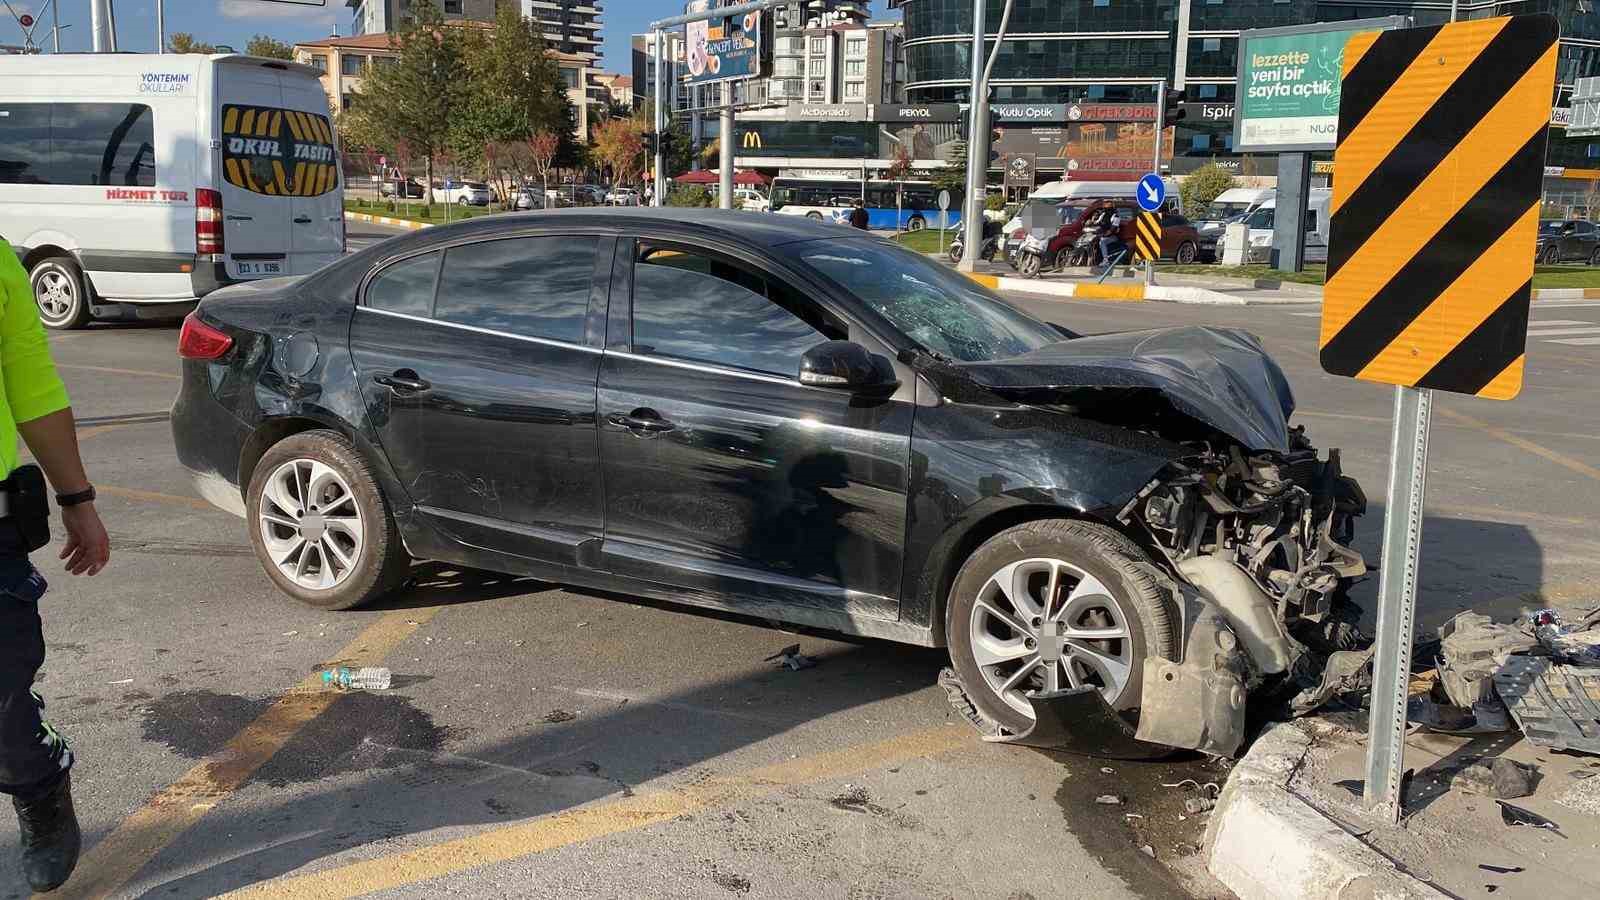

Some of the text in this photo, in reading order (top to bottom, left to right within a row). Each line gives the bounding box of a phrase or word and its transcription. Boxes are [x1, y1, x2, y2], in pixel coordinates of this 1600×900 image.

[1252, 51, 1309, 67] lezzette
[1251, 66, 1304, 85] yeni bir
[140, 83, 184, 92] OKULLARI
[1248, 80, 1331, 100] sayfa açtık
[799, 107, 850, 117] McDonald's
[1000, 106, 1053, 119] Kutlu Optik
[1202, 104, 1236, 120] ispir
[229, 138, 282, 158] OKUL
[106, 188, 156, 200] HİZMET
